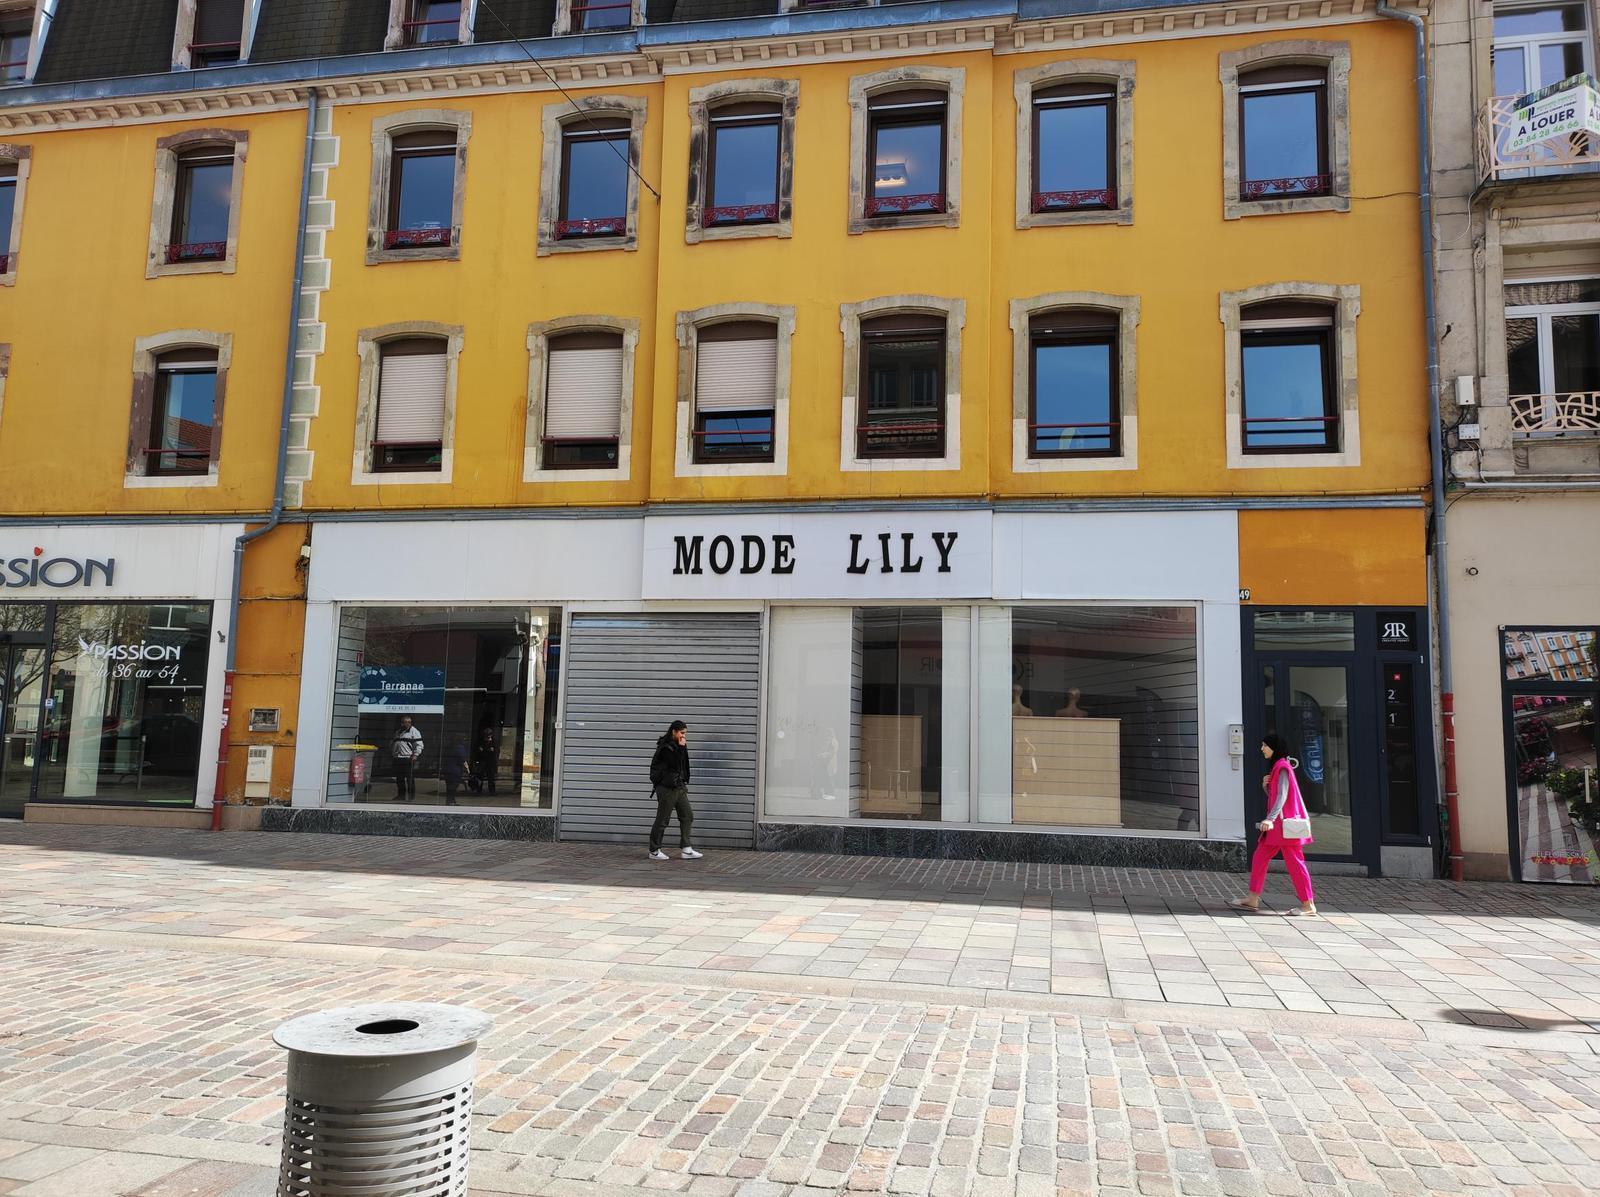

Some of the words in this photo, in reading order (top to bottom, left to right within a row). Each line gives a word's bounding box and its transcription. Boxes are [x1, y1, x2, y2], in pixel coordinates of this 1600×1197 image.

[1513, 138, 1524, 147] 03
[1526, 134, 1537, 143] 84
[1539, 128, 1550, 138] 28
[1552, 124, 1565, 133] 46
[1567, 119, 1580, 129] 66
[1518, 126, 1527, 137] A
[1531, 108, 1575, 131] LOUER
[672, 534, 797, 575] MODE
[846, 532, 959, 575] LILY
[0, 548, 115, 588] SION
[1239, 590, 1250, 600] 49
[94, 641, 181, 661] PASSION
[112, 663, 136, 678] 36
[135, 669, 154, 678] au
[158, 664, 180, 679] 54
[380, 680, 425, 690] Terranae
